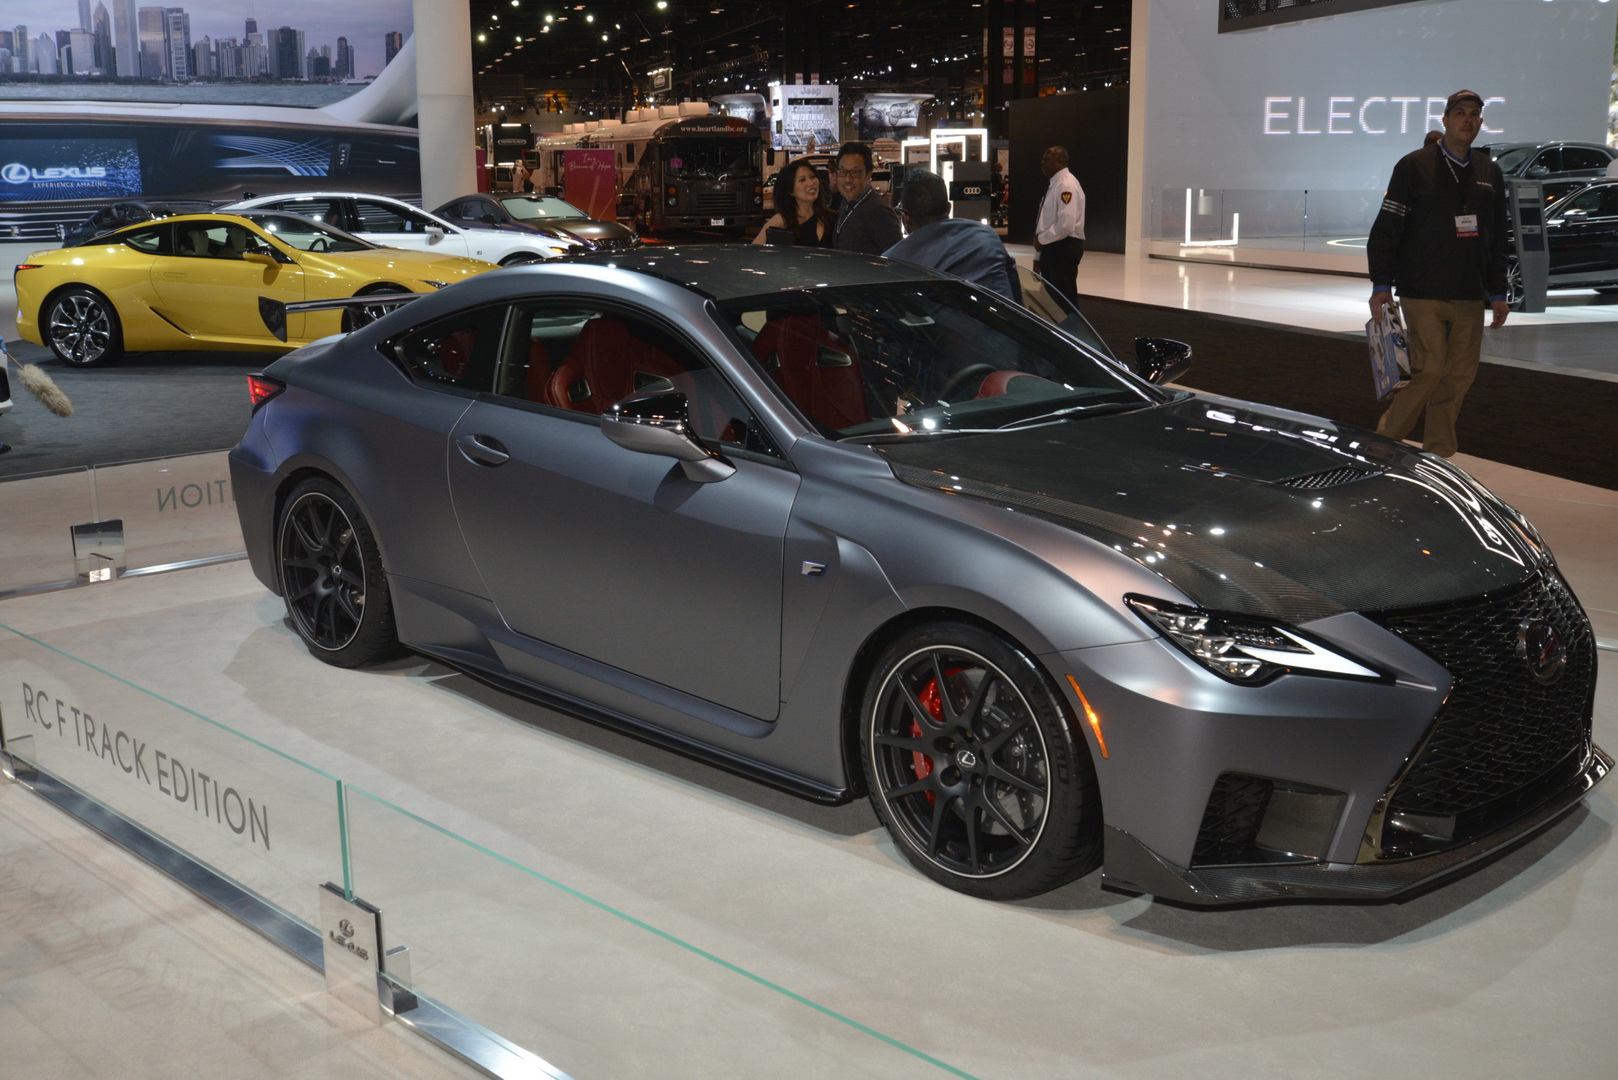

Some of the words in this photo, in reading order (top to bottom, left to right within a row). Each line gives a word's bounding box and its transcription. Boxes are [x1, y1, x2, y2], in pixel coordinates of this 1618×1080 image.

[801, 87, 822, 96] Jeep
[1263, 96, 1506, 134] ELECTRC
[32, 167, 107, 179] LEXUS
[22, 682, 52, 730] RC
[56, 698, 66, 737] F
[70, 705, 151, 785] TRACK
[155, 749, 270, 851] EDITION
